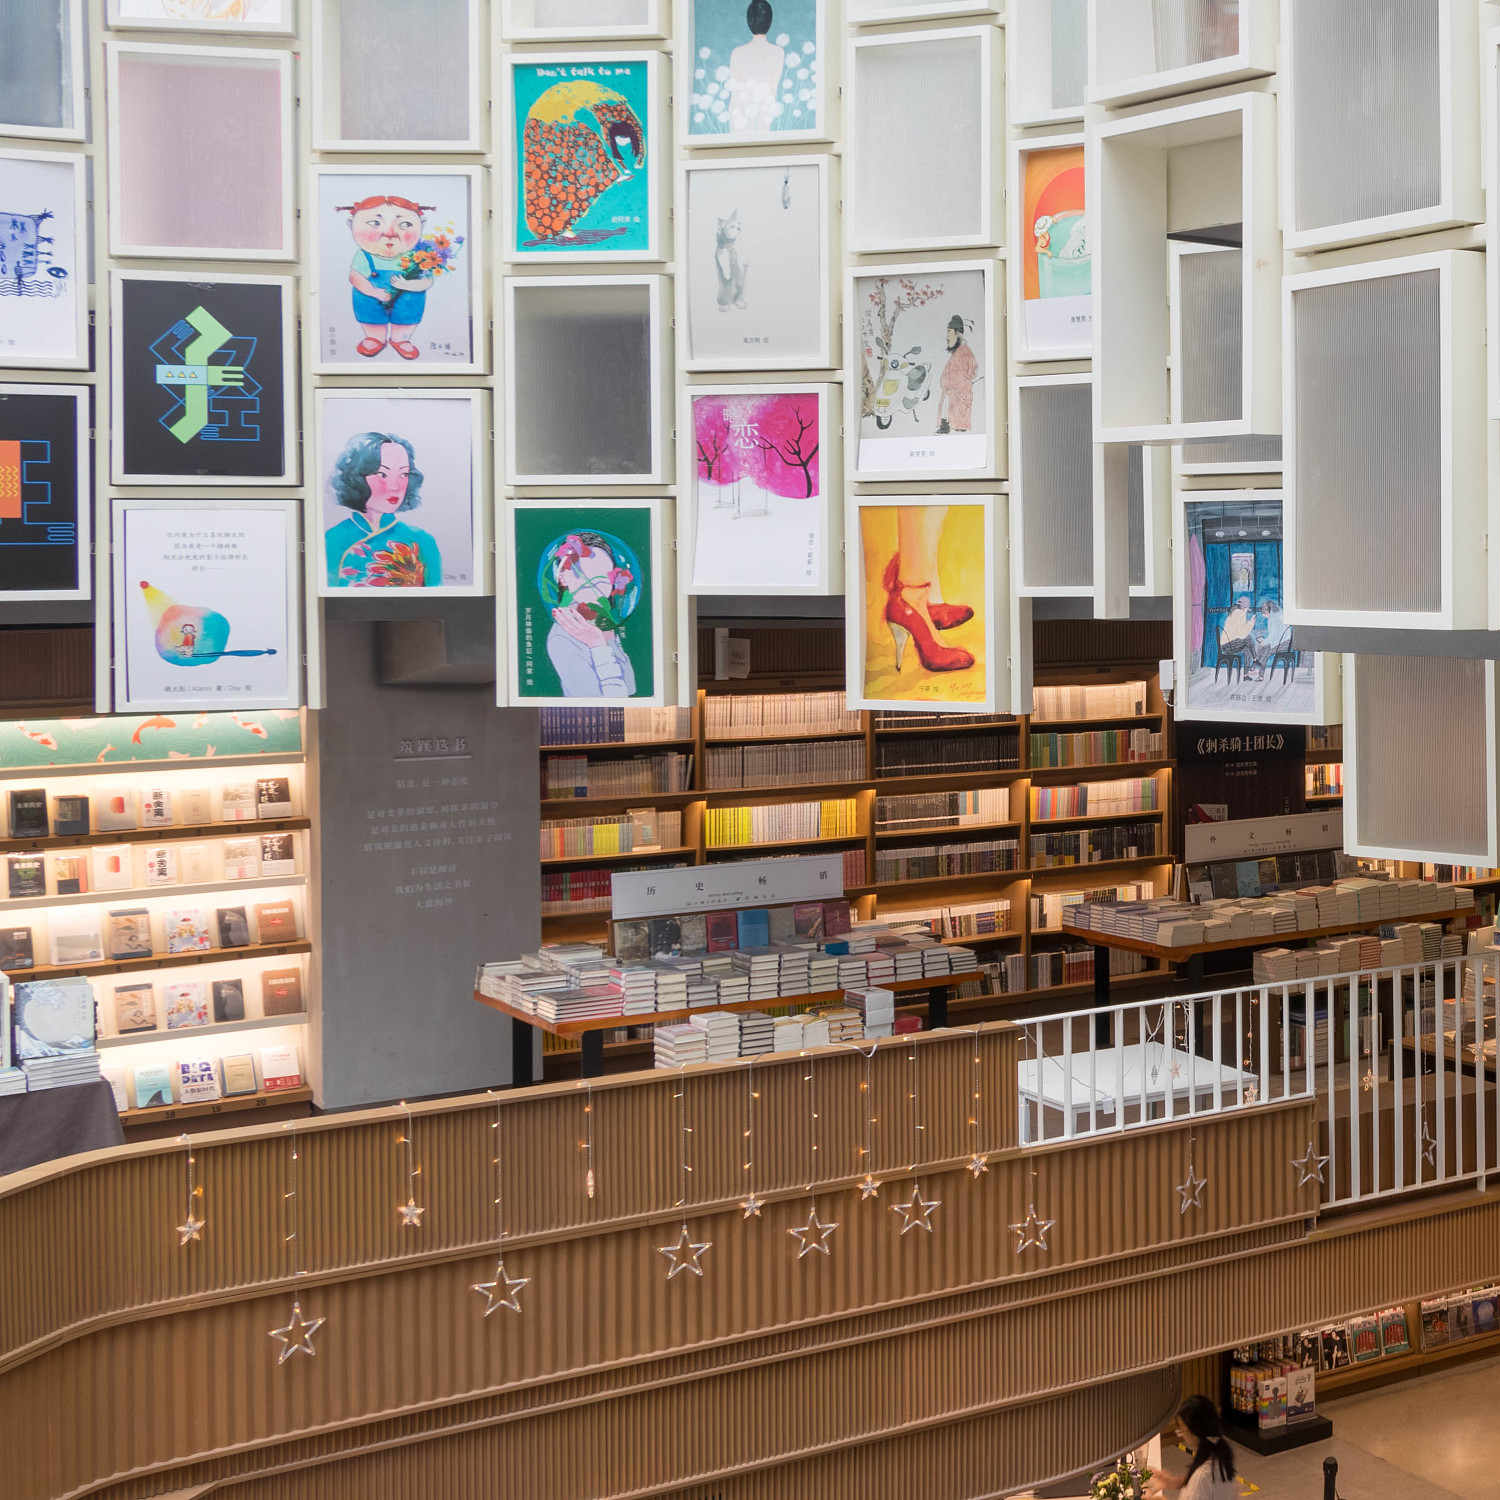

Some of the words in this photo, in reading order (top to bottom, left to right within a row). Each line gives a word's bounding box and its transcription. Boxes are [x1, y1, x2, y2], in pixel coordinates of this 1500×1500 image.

[536, 67, 567, 78] Don't
[570, 66, 595, 77] talk
[598, 66, 612, 76] to
[615, 67, 632, 76] me
[1196, 733, 1284, 755] 《刺杀骑士团长》
[646, 870, 828, 896] 历史畅销
[180, 1061, 212, 1075] BIG
[184, 1085, 216, 1094] 大数据时代
[165, 1111, 176, 1119] 18
[211, 1105, 222, 1113] 19
[256, 1098, 267, 1106] 20
